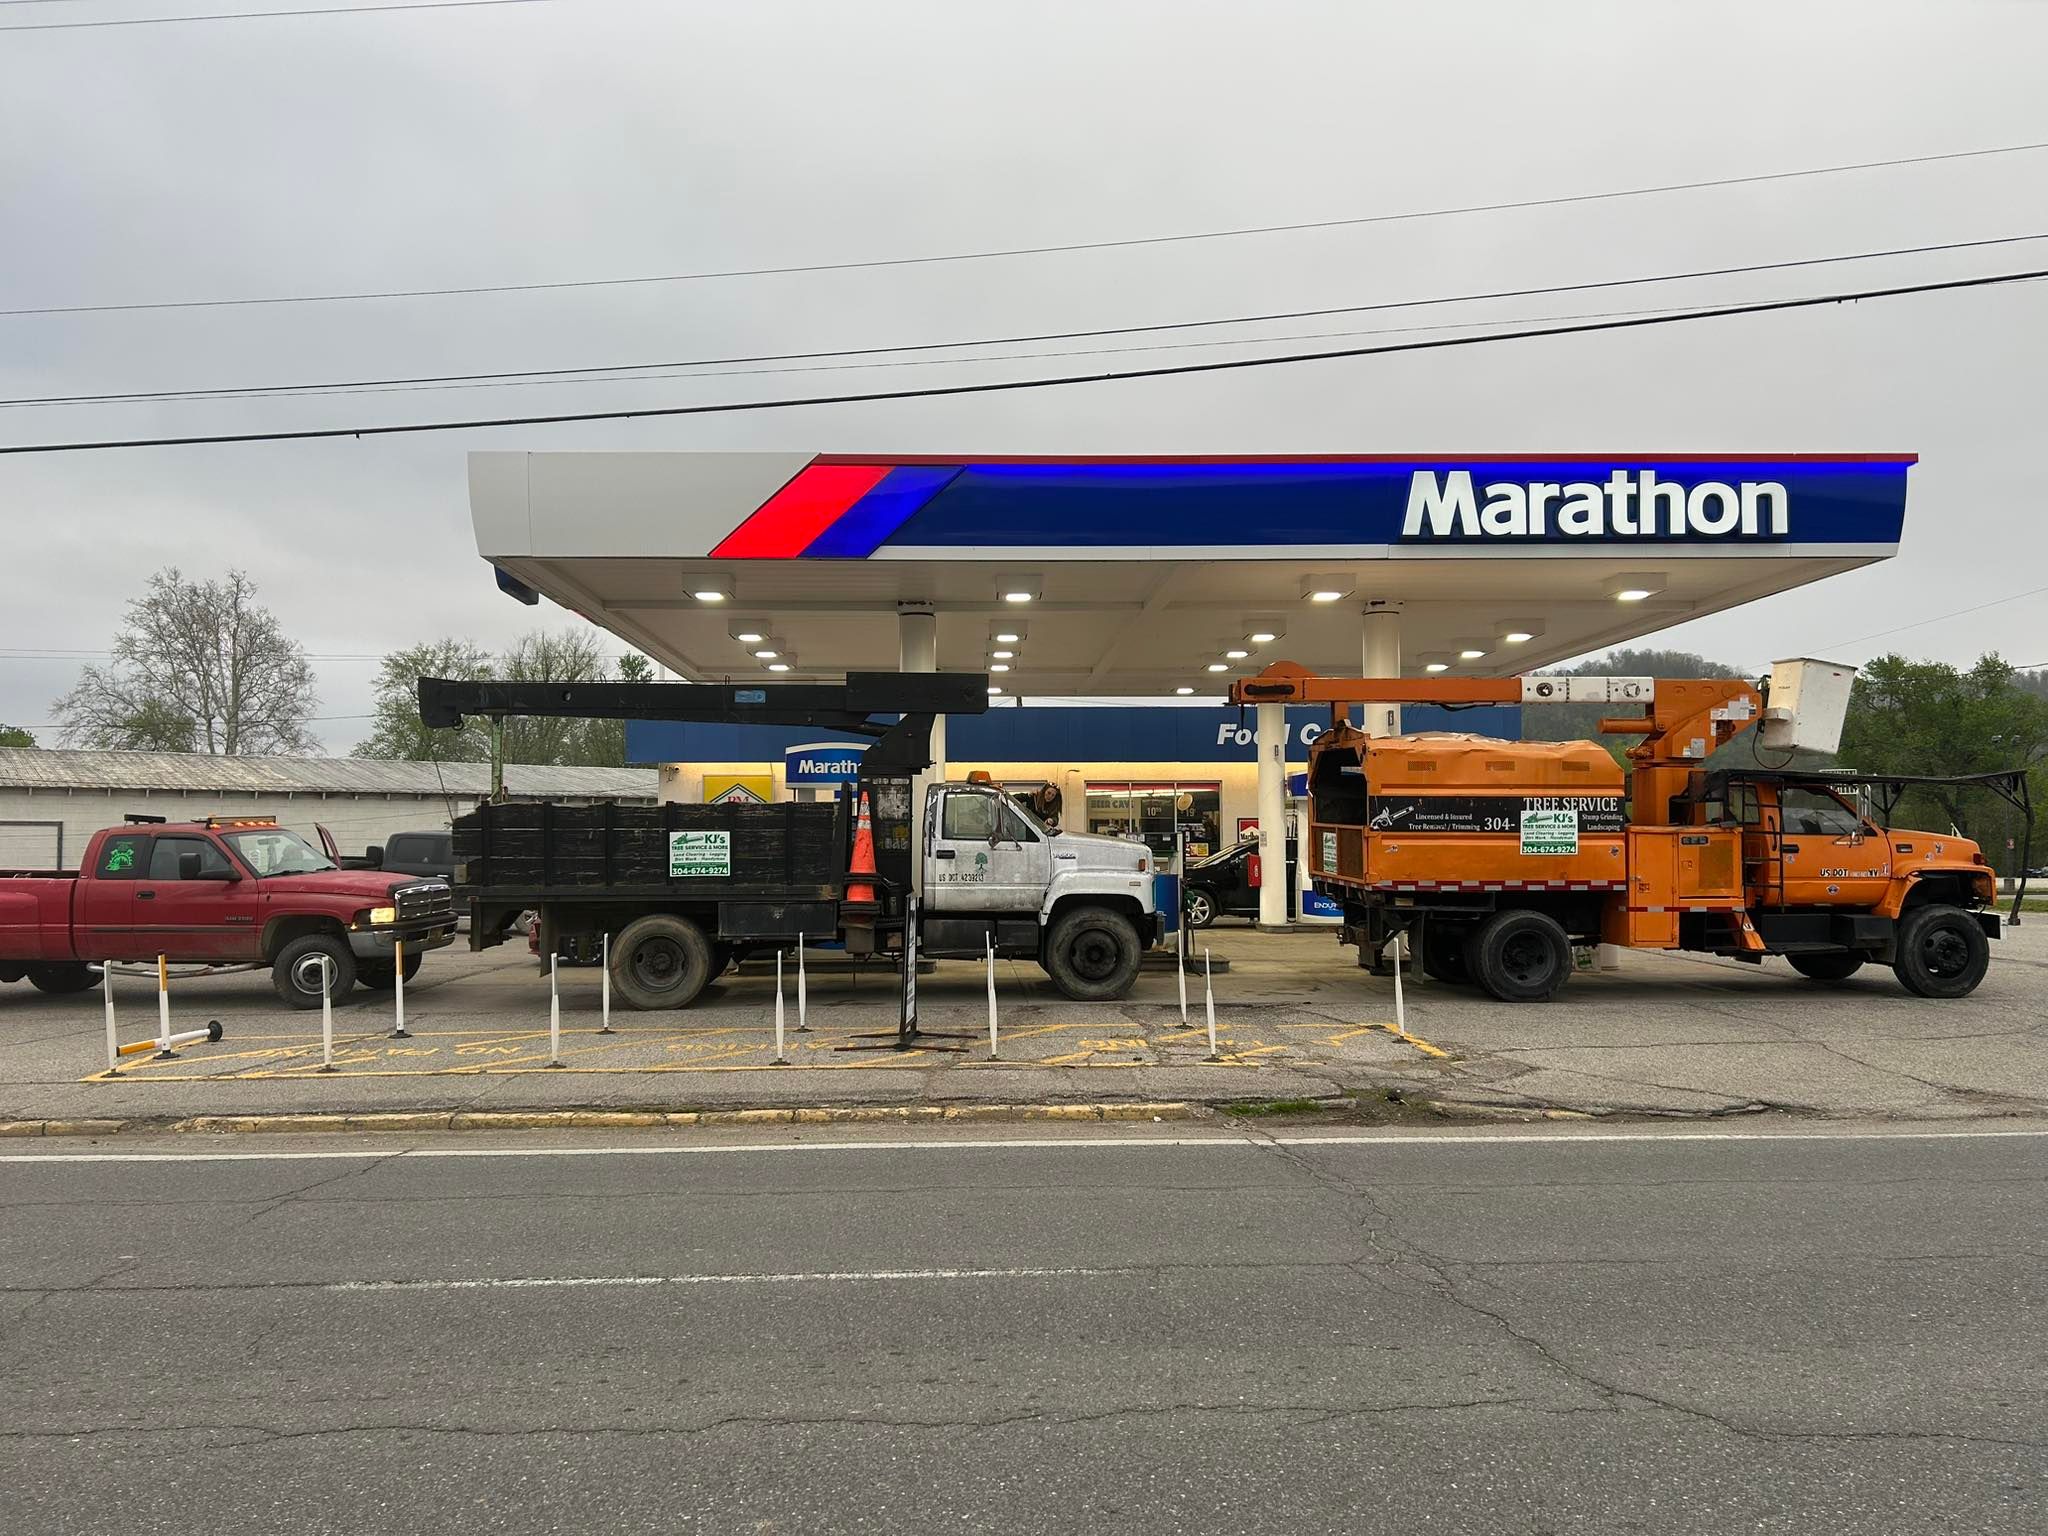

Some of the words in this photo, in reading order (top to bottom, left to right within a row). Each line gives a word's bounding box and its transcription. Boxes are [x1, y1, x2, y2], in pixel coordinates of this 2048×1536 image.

[1402, 470, 1788, 536] Marathon
[798, 760, 858, 774] Marath
[1112, 800, 1134, 808] CAV
[1523, 797, 1559, 811] TREE
[1562, 797, 1618, 812] SERVICE
[1554, 813, 1574, 823] KJ's
[1452, 823, 1480, 831] Trimming
[1484, 817, 1516, 830] 304-
[1587, 824, 1621, 832] Landscaping
[704, 834, 726, 844] KJ's
[672, 867, 728, 875] 304-674-9274
